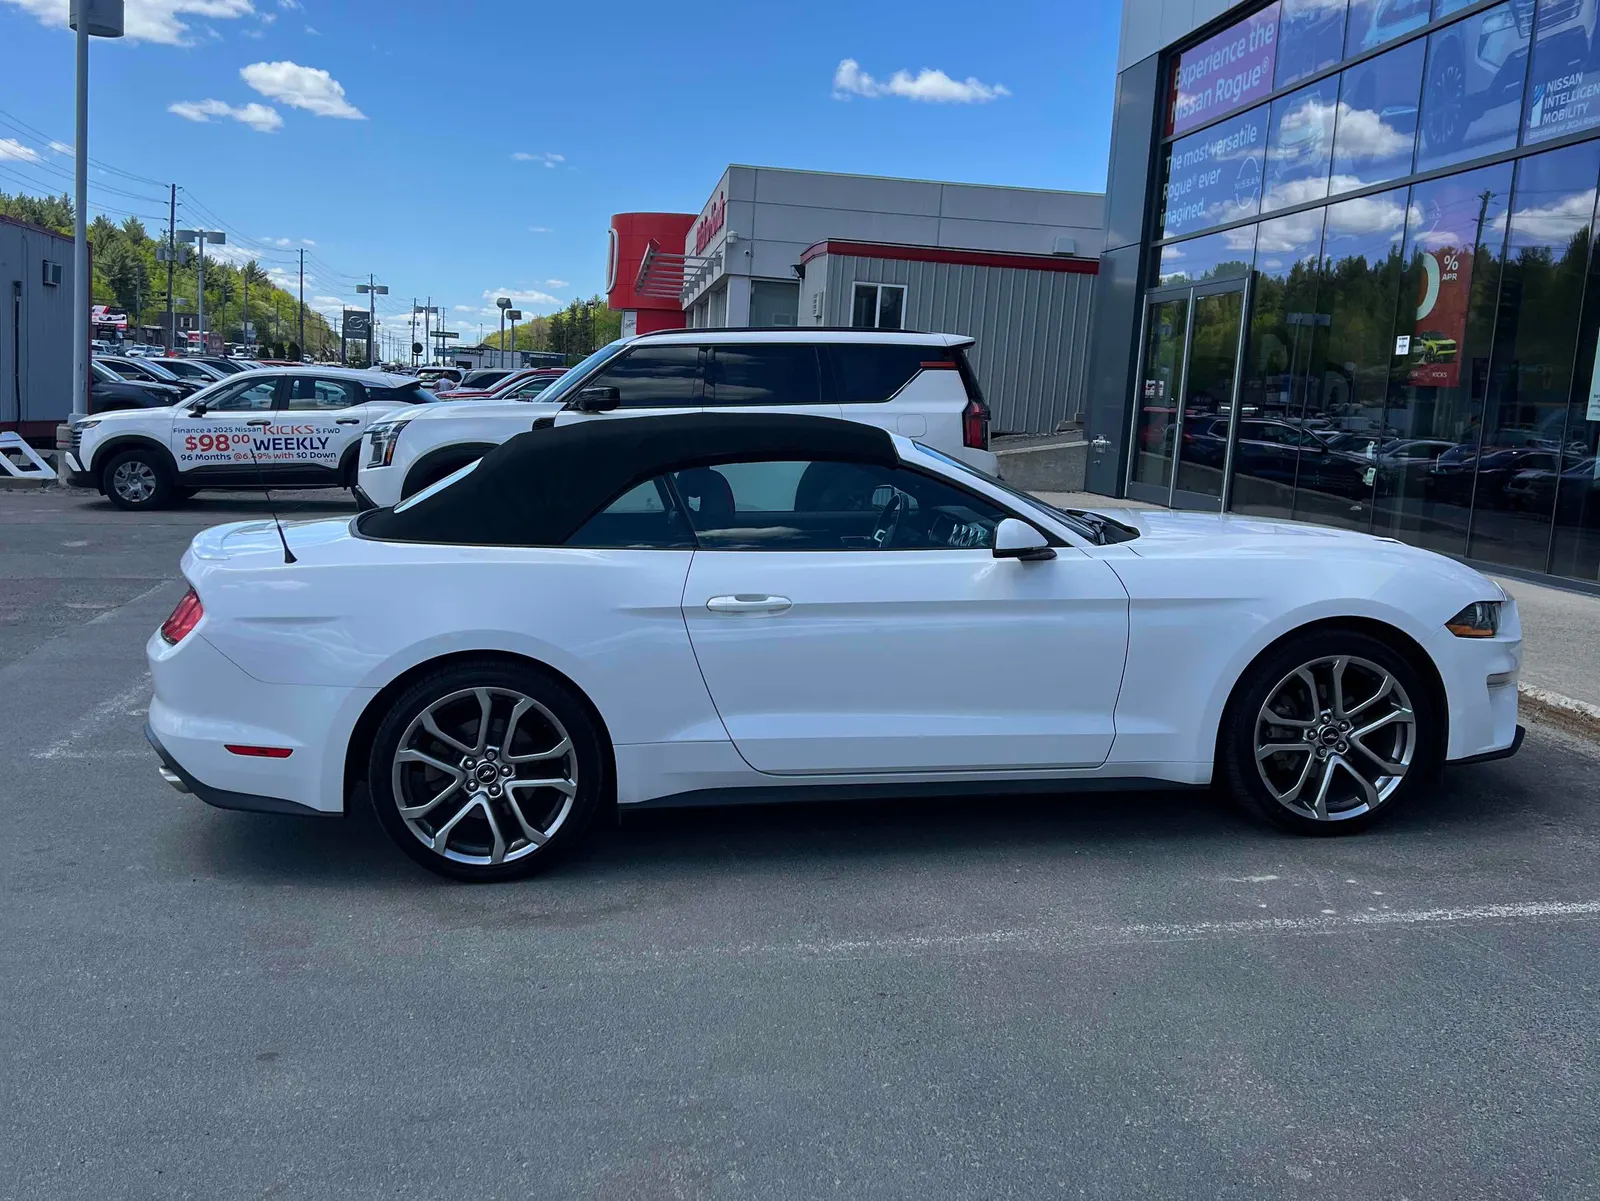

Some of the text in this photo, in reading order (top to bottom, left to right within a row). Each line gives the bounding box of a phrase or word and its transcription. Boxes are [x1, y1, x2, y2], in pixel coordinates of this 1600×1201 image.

[1174, 22, 1275, 90] Experience the
[1546, 71, 1583, 94] NISSAN
[1170, 87, 1212, 124] Nissan
[1542, 102, 1590, 126] MOBILITY
[1166, 124, 1257, 173] The most versatile
[1198, 168, 1222, 189] ever
[1234, 175, 1261, 191] NISSAN
[1159, 197, 1206, 227] imagined.
[1441, 272, 1458, 281] APR
[263, 424, 314, 435] KICKS
[252, 436, 330, 451] WEEKLY
[180, 453, 193, 461] 96
[195, 453, 232, 461] Months
[296, 451, 307, 459] $0
[310, 451, 337, 459] Down
